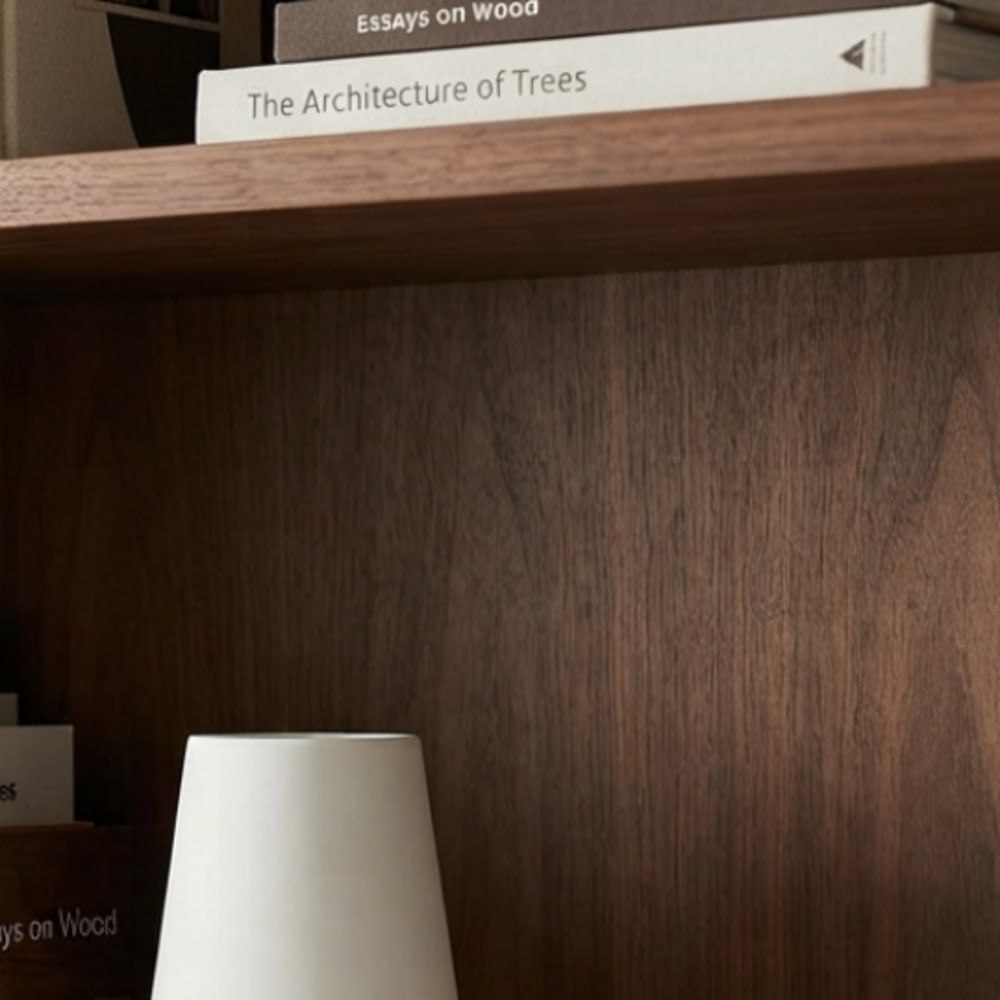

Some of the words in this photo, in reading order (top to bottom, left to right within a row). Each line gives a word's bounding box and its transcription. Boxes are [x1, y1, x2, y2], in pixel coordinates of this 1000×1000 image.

[436, 6, 466, 25] on
[247, 91, 294, 120] The
[302, 80, 468, 115] Architecture
[477, 69, 507, 100] of
[511, 69, 588, 97] Trees
[28, 919, 54, 941] on
[57, 906, 118, 938] Wood
